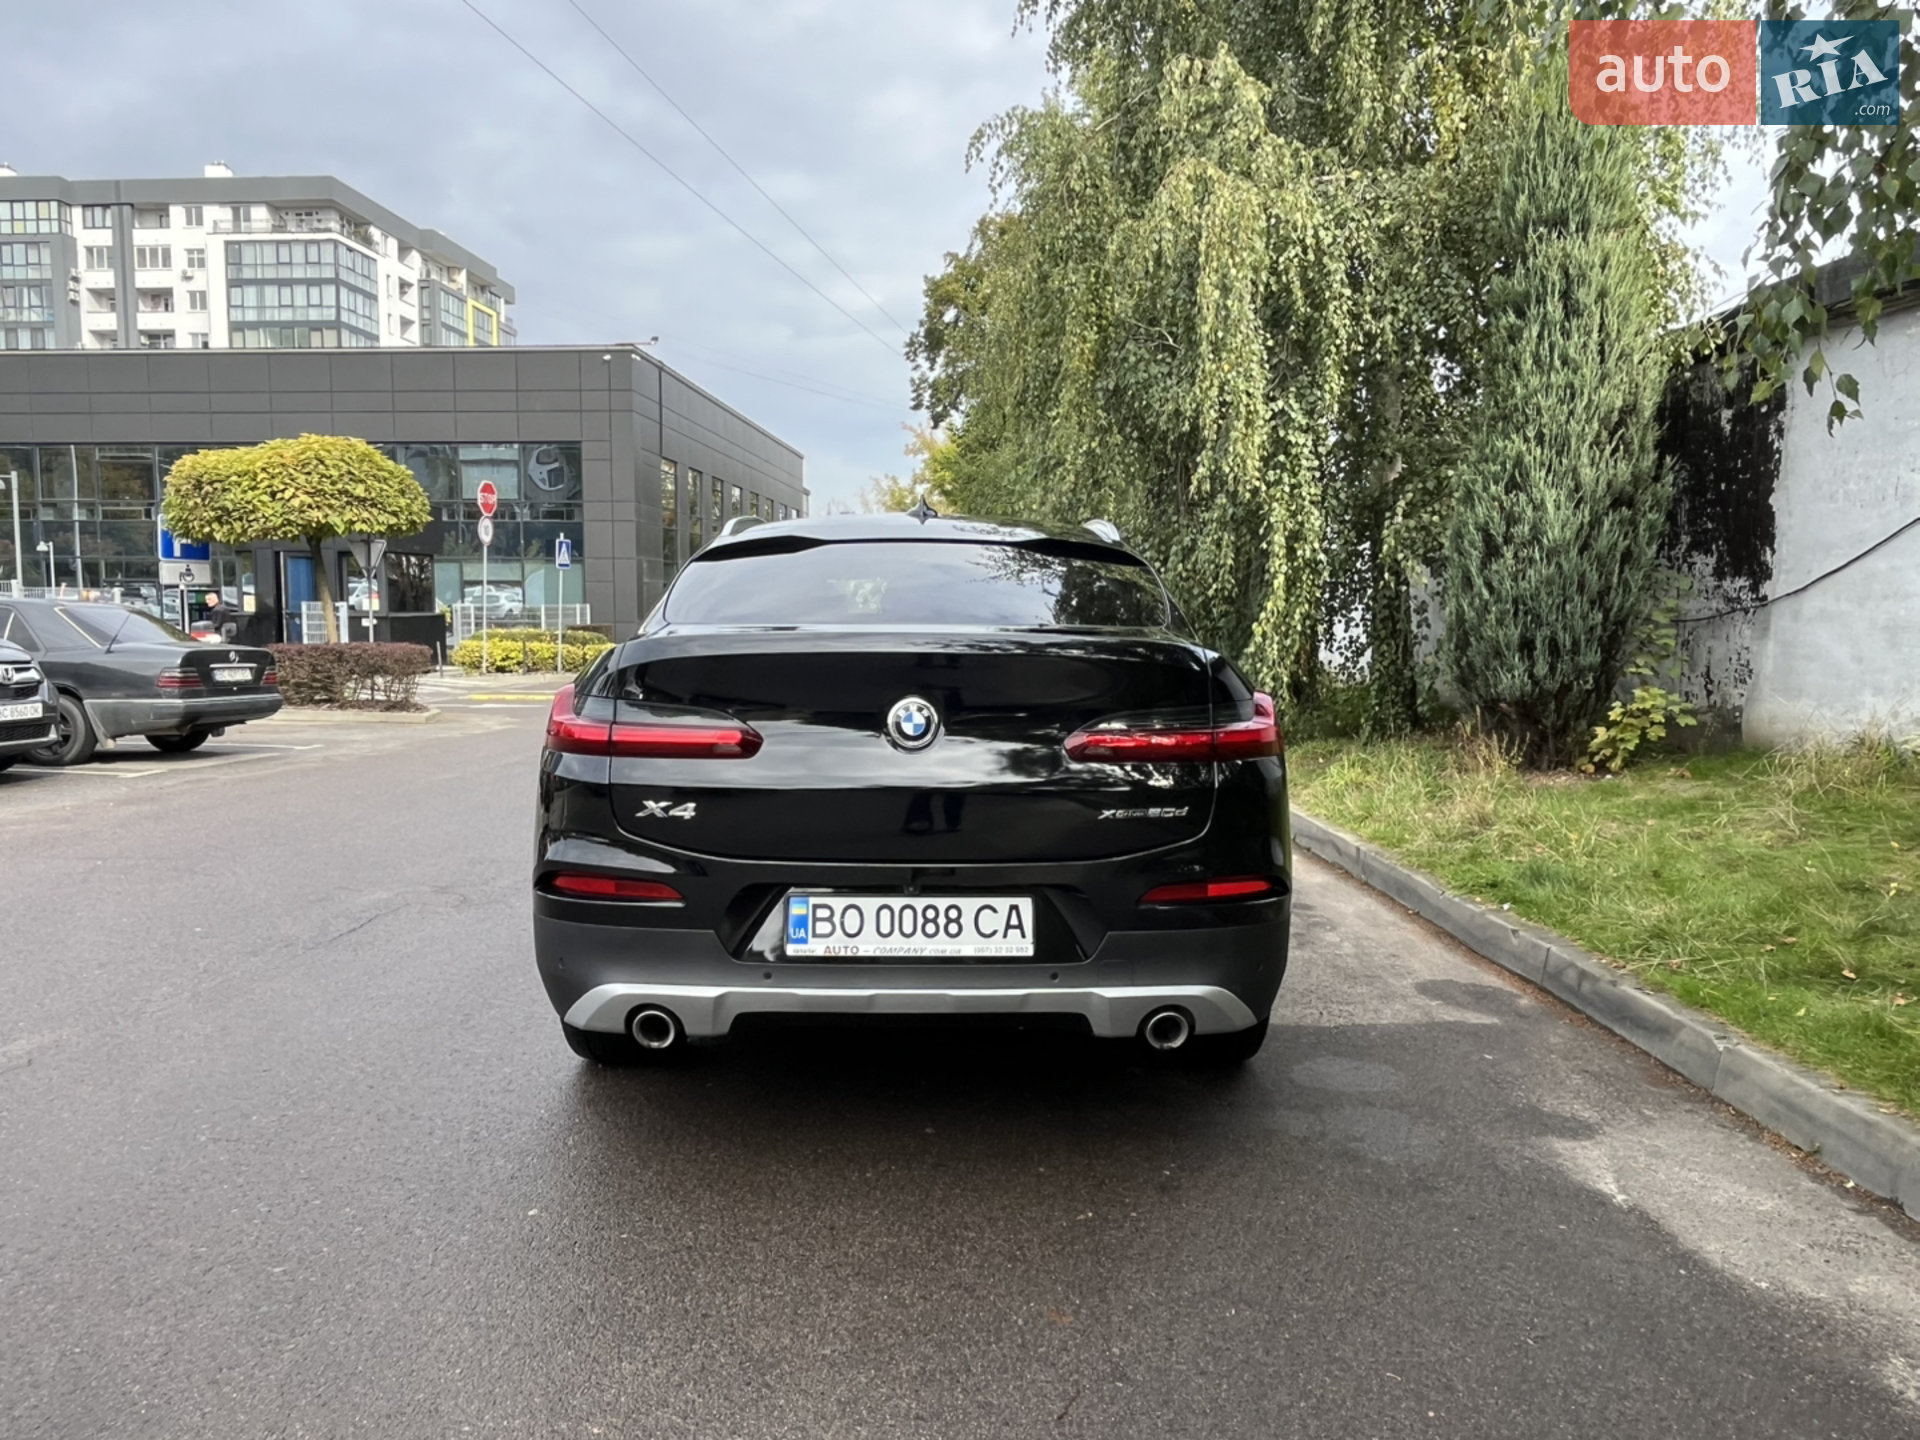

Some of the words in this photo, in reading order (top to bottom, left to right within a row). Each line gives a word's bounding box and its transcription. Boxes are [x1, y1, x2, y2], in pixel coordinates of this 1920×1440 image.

[480, 493, 496, 504] STOP
[634, 800, 697, 820] X4
[811, 903, 865, 938] BO
[875, 903, 963, 938] 0088
[973, 904, 1027, 939] CA
[791, 928, 807, 939] UA
[823, 945, 859, 956] AUTO
[873, 946, 928, 955] COMPANY
